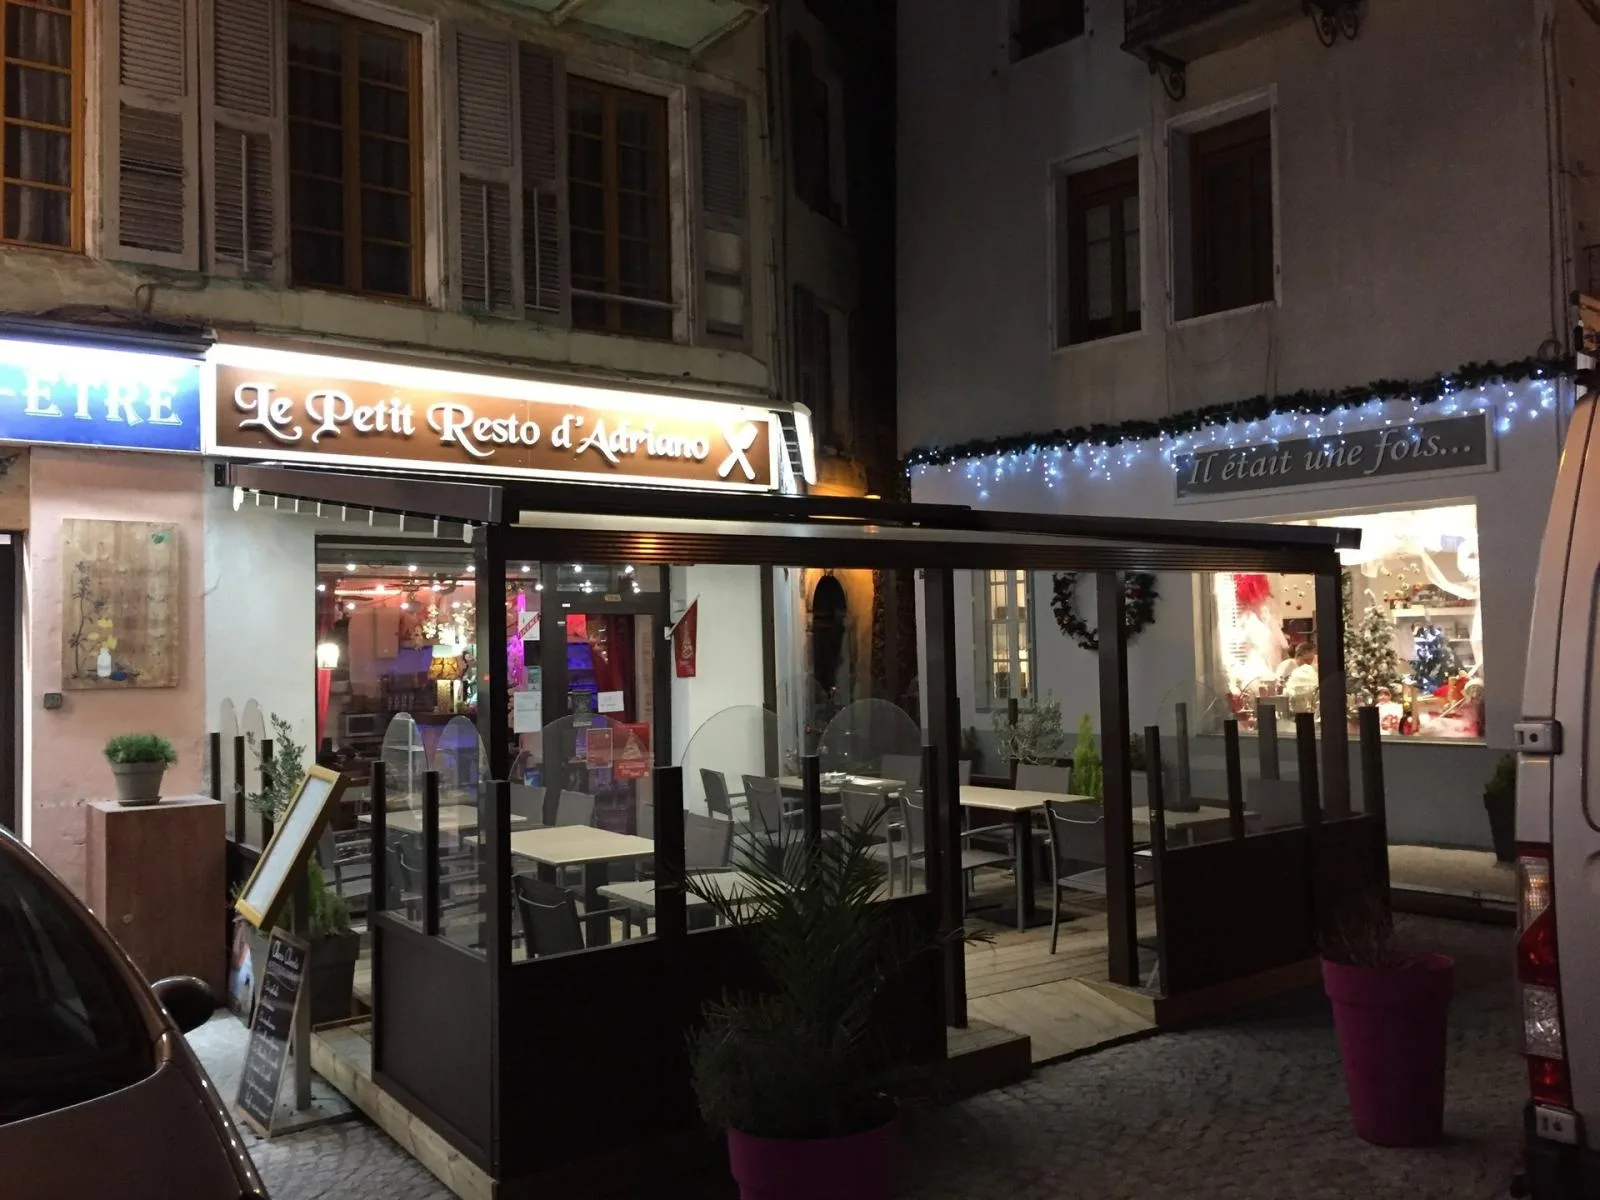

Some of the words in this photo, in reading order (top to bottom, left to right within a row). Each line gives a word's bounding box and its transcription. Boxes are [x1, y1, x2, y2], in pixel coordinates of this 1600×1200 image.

[234, 382, 303, 441] Le
[304, 389, 416, 444] Petit
[426, 402, 541, 457] Resto
[551, 414, 710, 464] d'Adriano
[1187, 453, 1219, 485] Il
[1303, 444, 1363, 471] une
